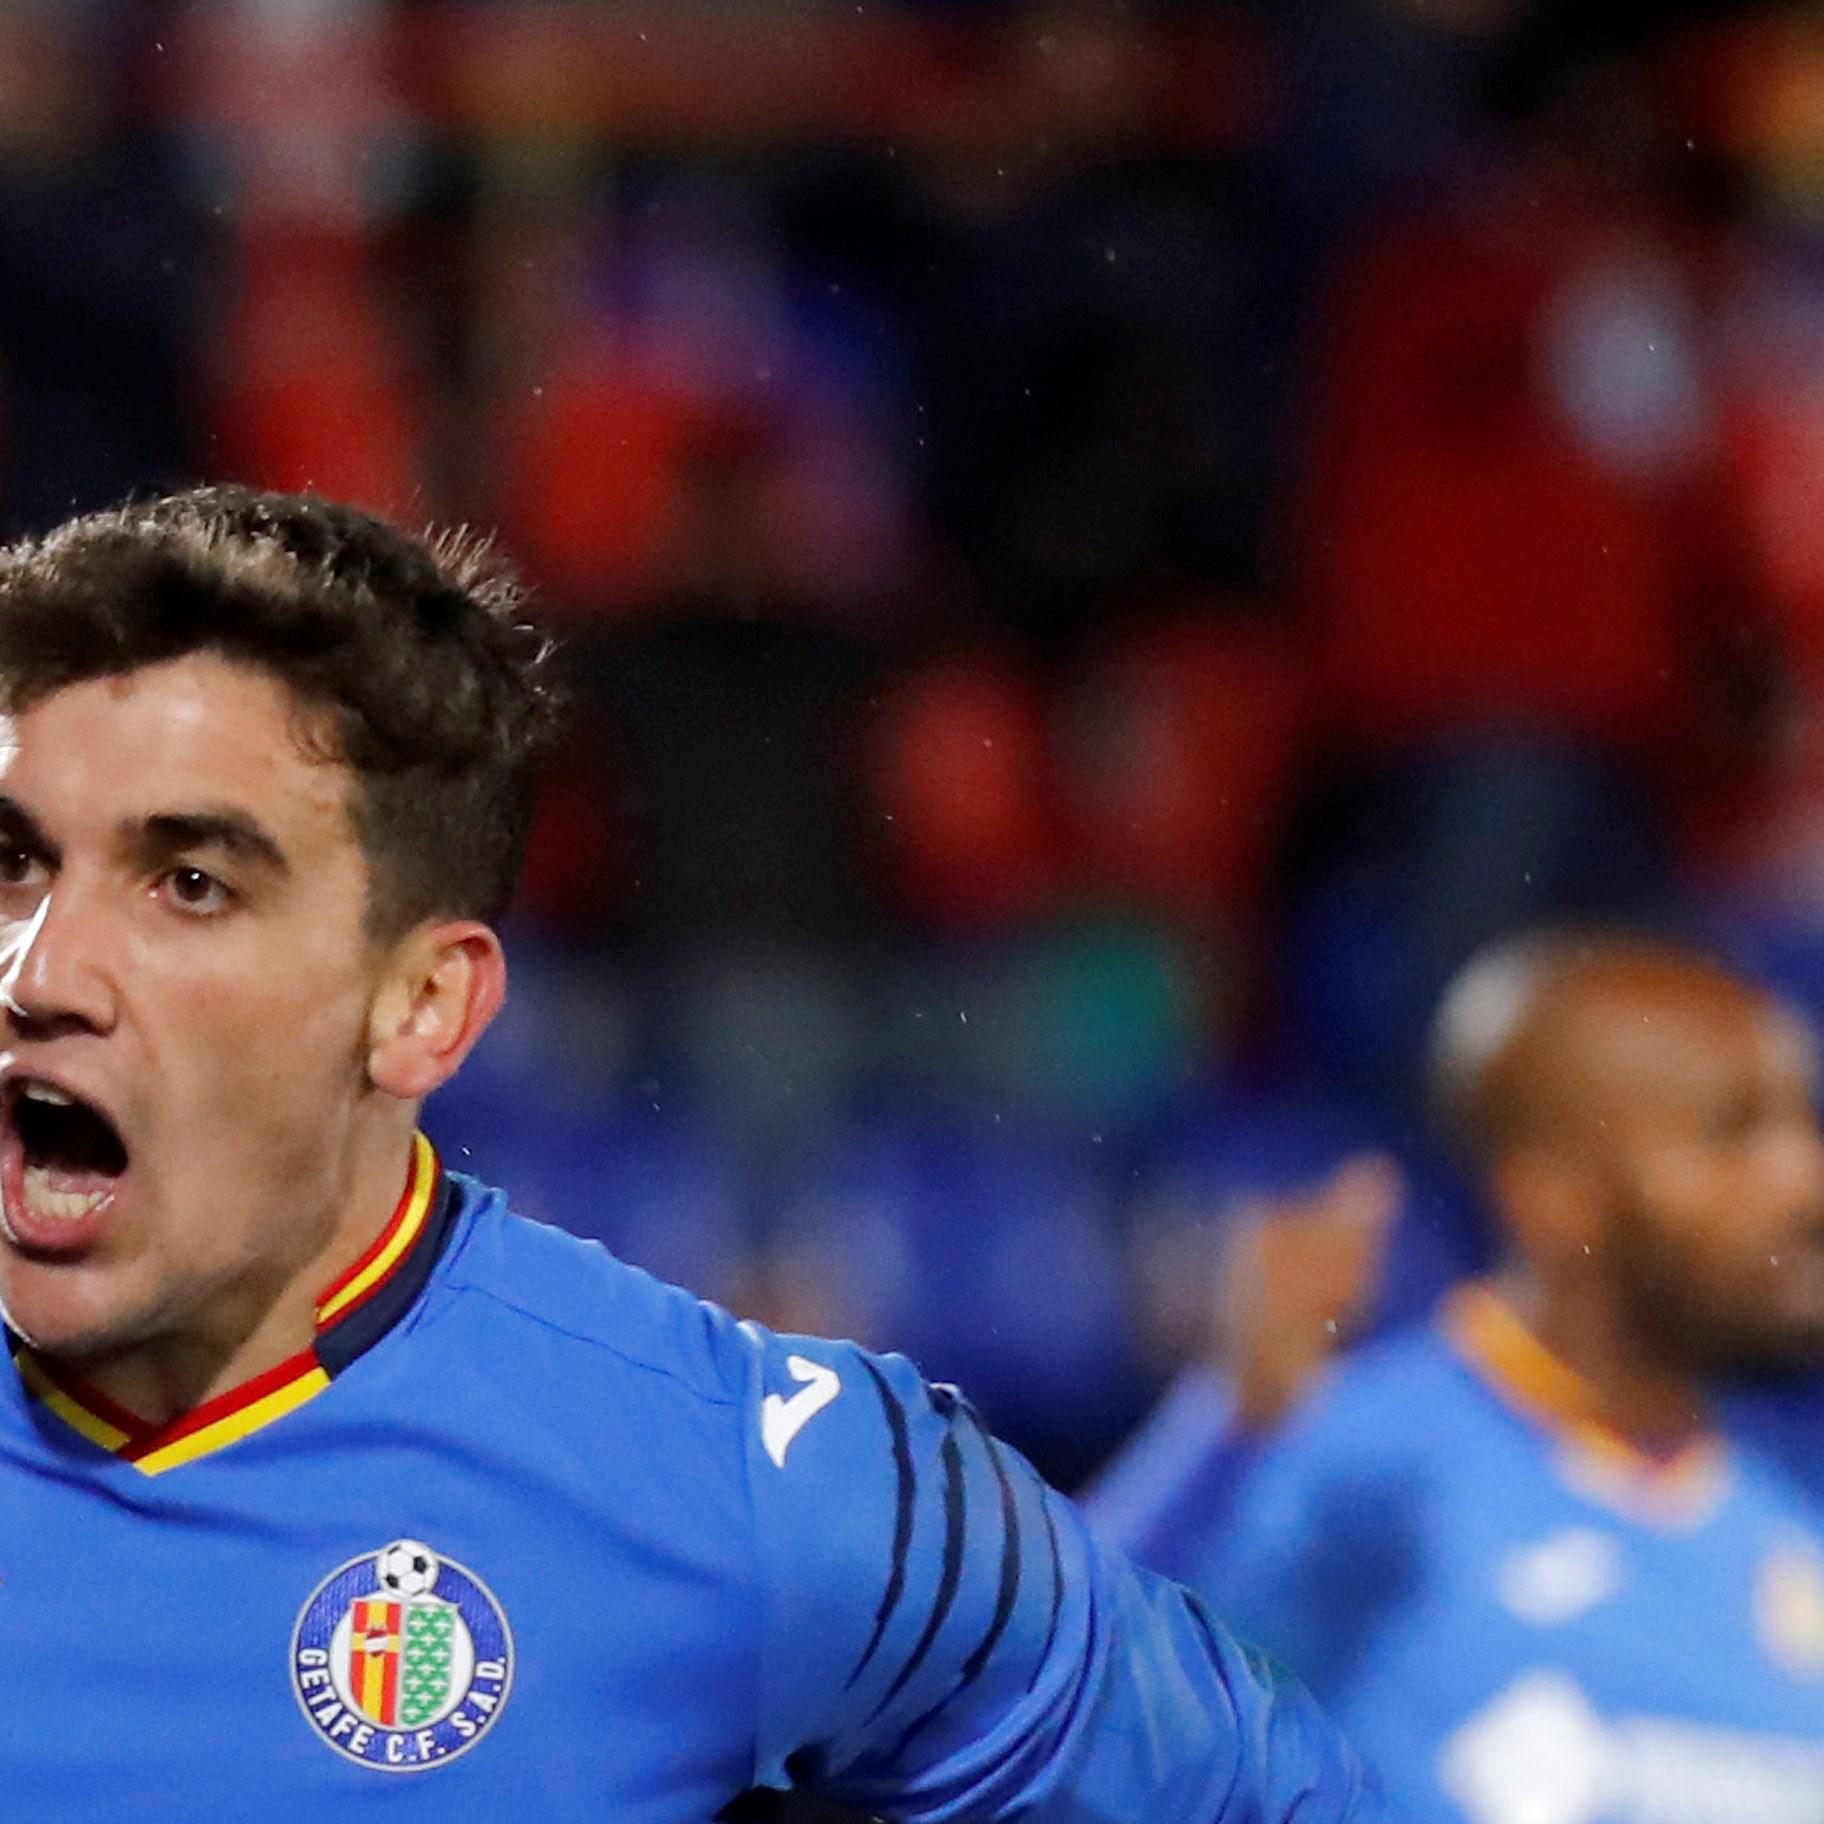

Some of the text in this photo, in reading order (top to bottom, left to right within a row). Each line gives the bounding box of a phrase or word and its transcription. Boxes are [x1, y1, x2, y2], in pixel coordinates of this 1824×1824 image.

[298, 1649, 506, 1763] GETAFE C.F. S.A.D.
